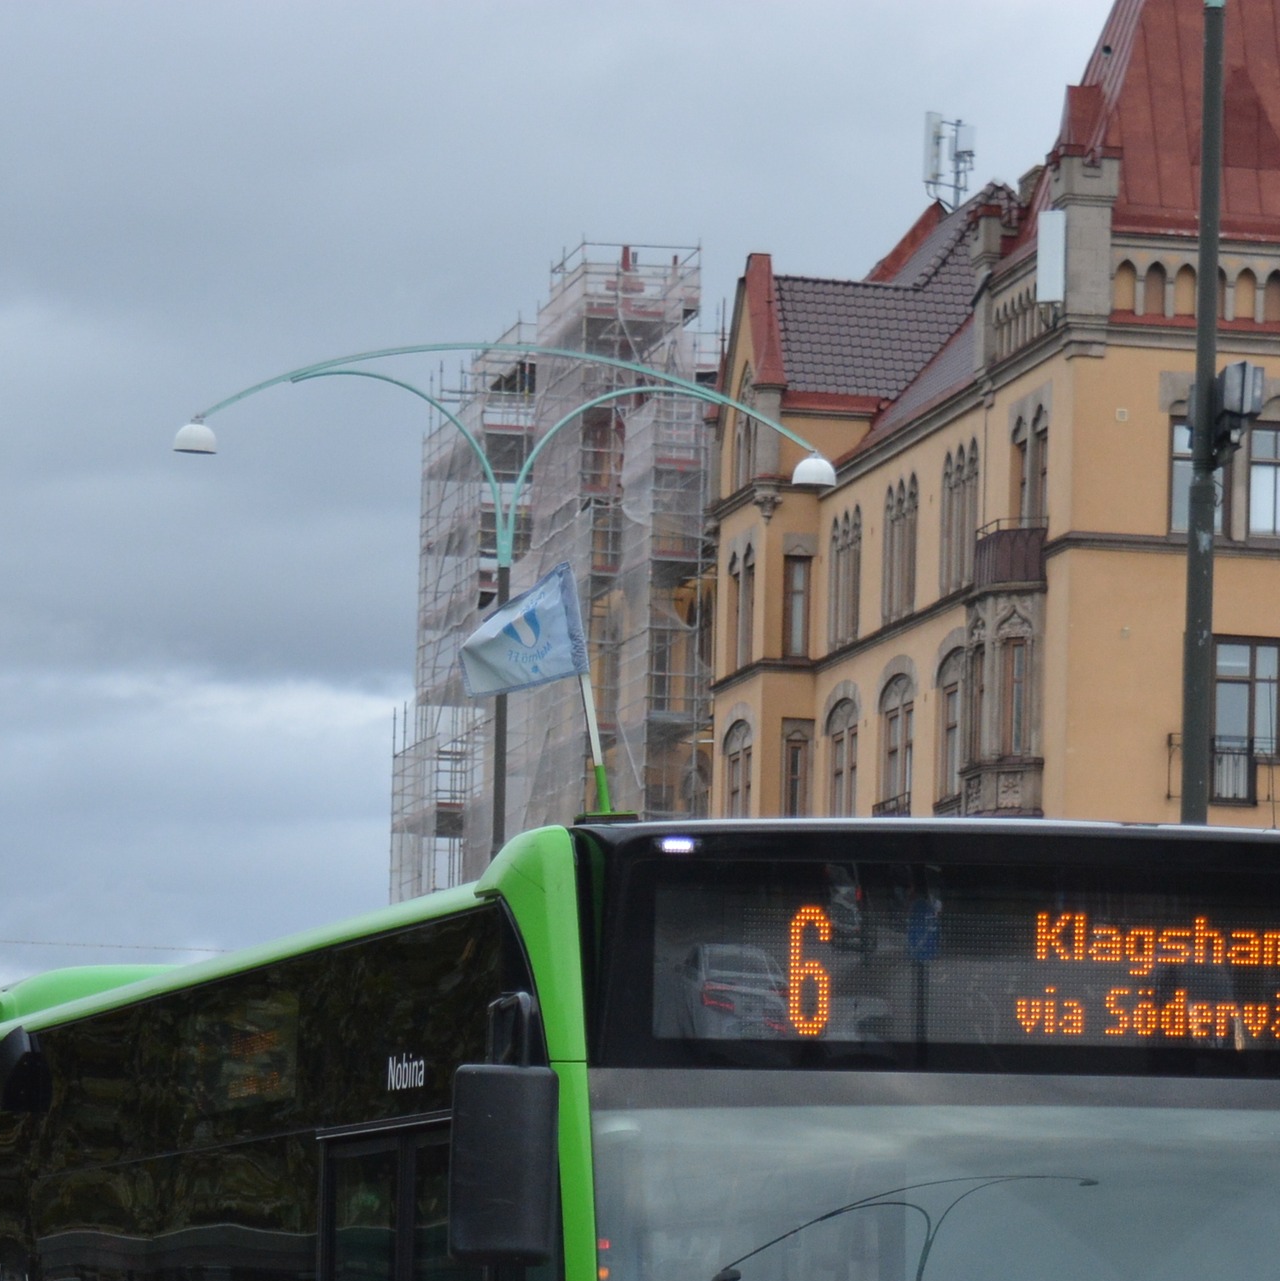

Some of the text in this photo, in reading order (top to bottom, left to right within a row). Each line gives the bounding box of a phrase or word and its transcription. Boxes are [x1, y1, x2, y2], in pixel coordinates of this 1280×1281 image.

[789, 905, 831, 1035] 6
[1016, 987, 1085, 1035] via
[387, 1052, 425, 1091] Nobina
